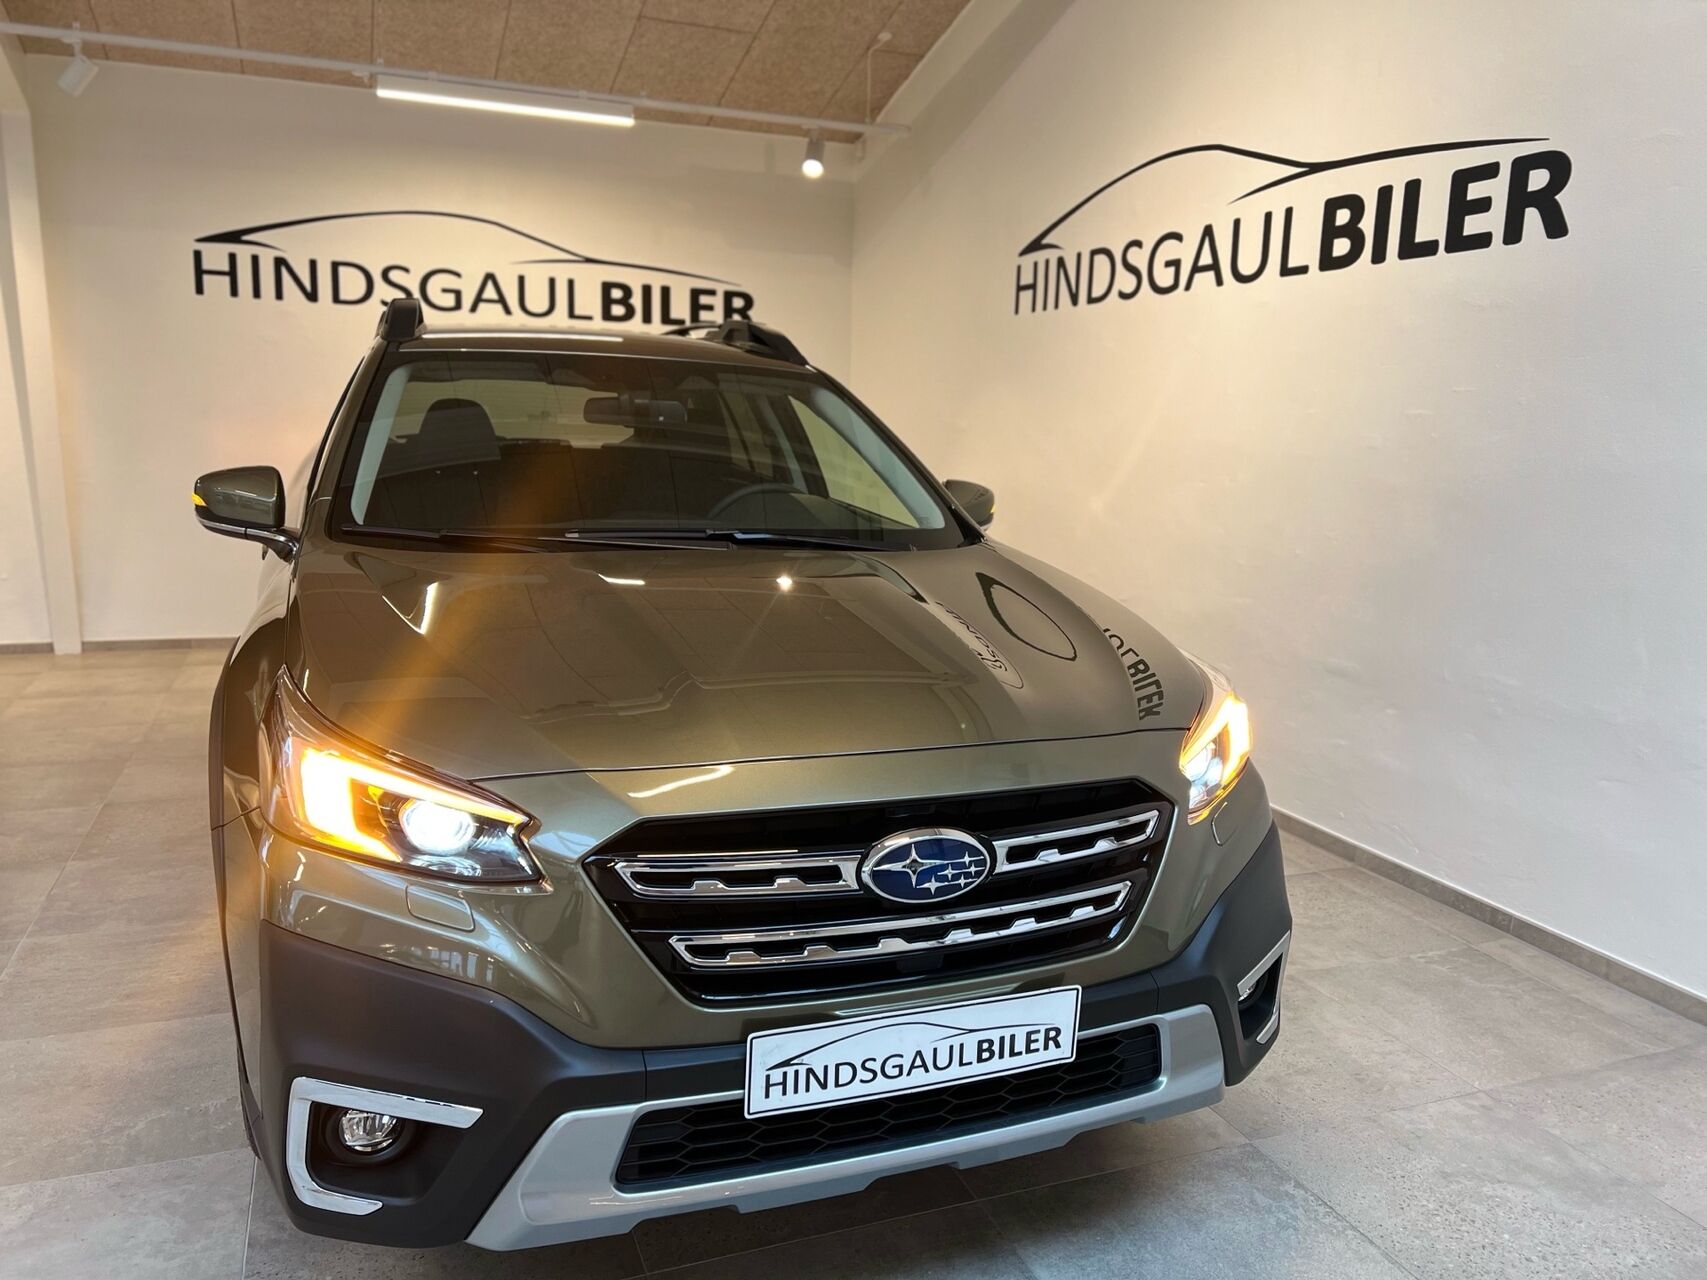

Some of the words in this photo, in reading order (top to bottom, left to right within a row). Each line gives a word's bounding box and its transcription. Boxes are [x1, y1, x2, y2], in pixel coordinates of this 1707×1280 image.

[1014, 150, 1572, 315] HINDSGAULBILER
[193, 249, 755, 326] HINDSGAULBILER
[764, 1026, 1062, 1099] HINDSGAULBILER
